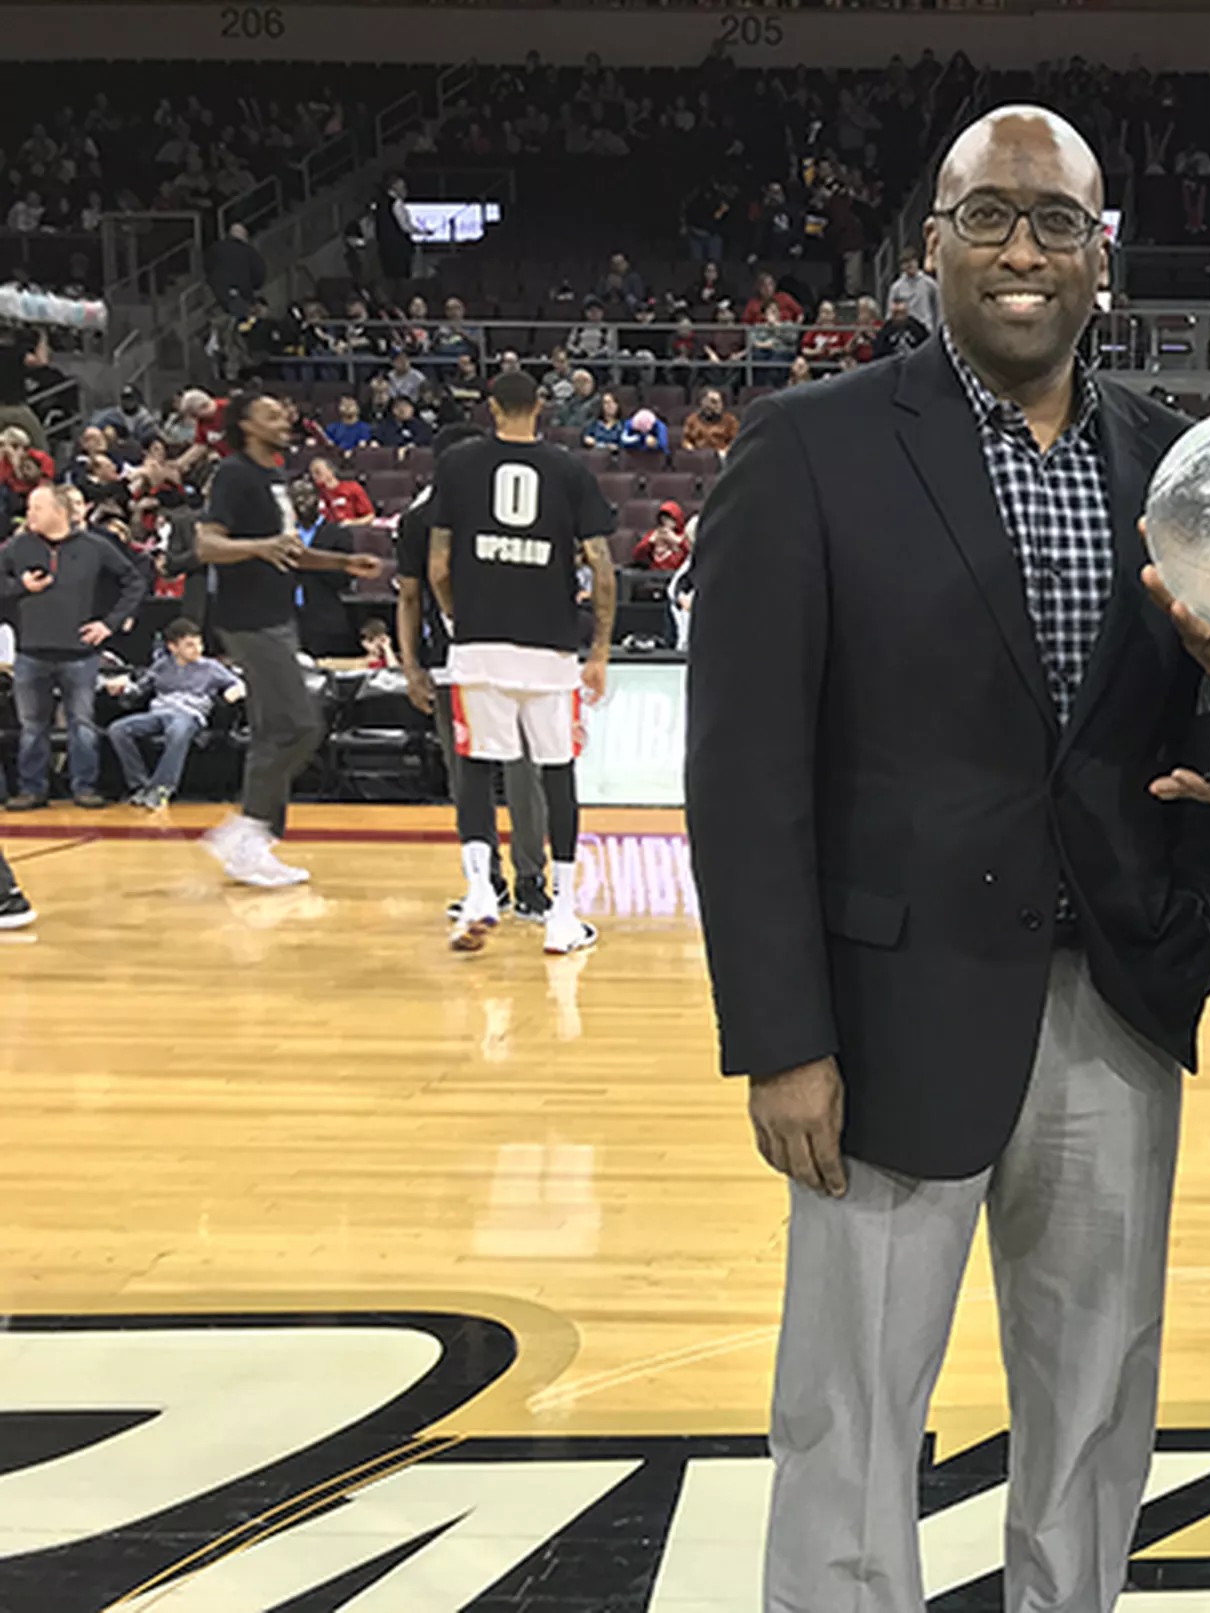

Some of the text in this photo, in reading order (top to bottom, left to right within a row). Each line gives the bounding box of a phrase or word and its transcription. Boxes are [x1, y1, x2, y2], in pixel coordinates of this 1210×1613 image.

[220, 6, 286, 39] 206
[719, 14, 784, 46] 205
[494, 463, 539, 526] 0
